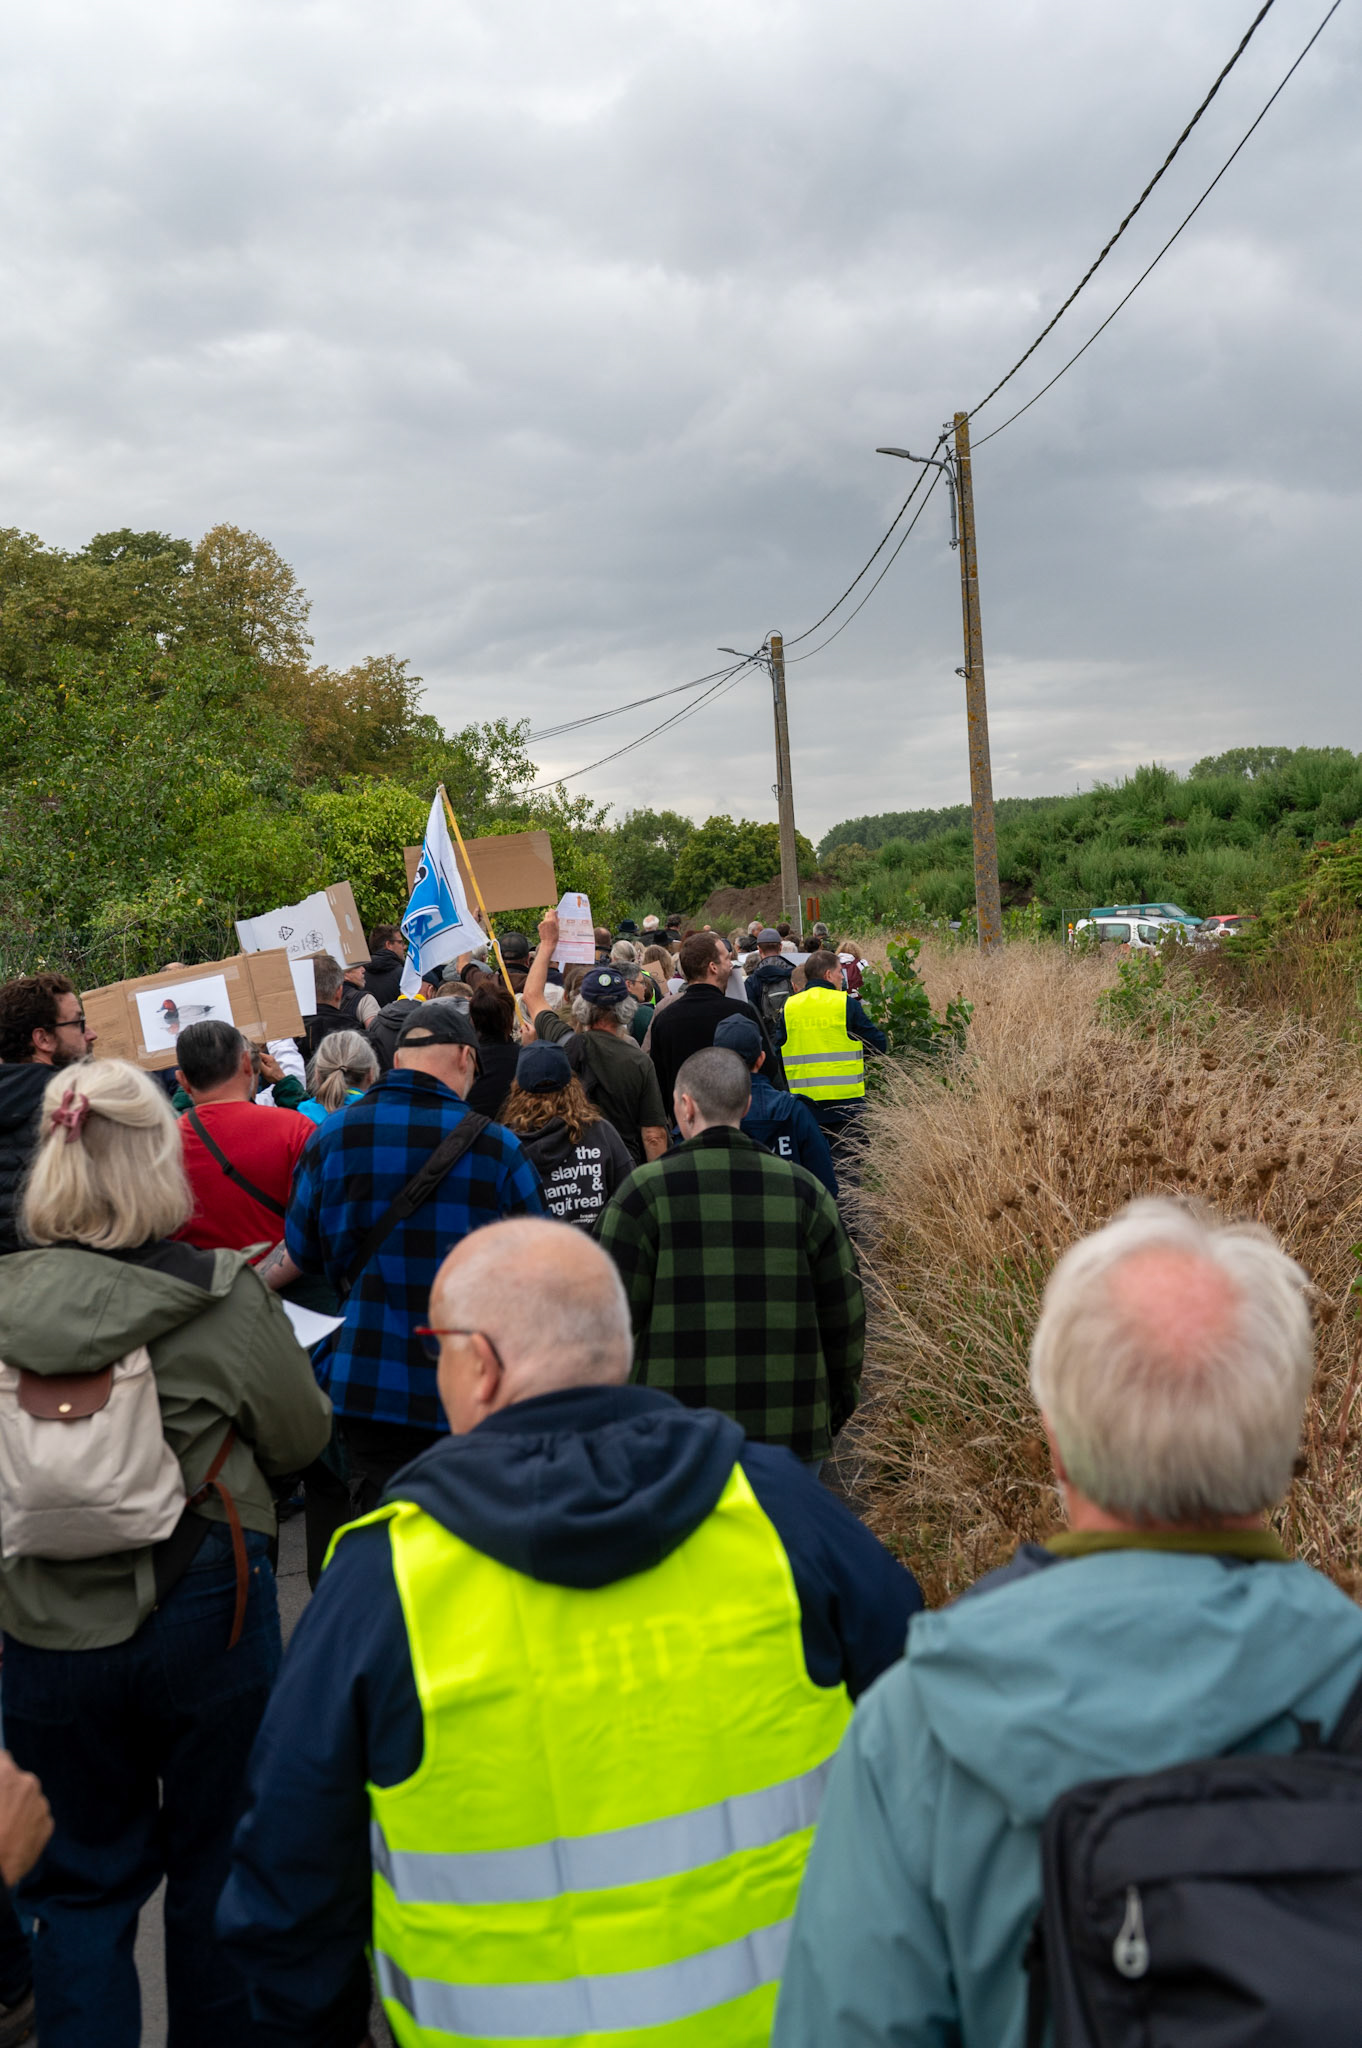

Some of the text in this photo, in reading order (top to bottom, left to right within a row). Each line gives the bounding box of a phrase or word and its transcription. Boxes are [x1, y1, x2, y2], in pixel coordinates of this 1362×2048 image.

[575, 1146, 601, 1159] the
[550, 1162, 602, 1181] slaying
[591, 1177, 604, 1191] &
[574, 1192, 604, 1209] real.
